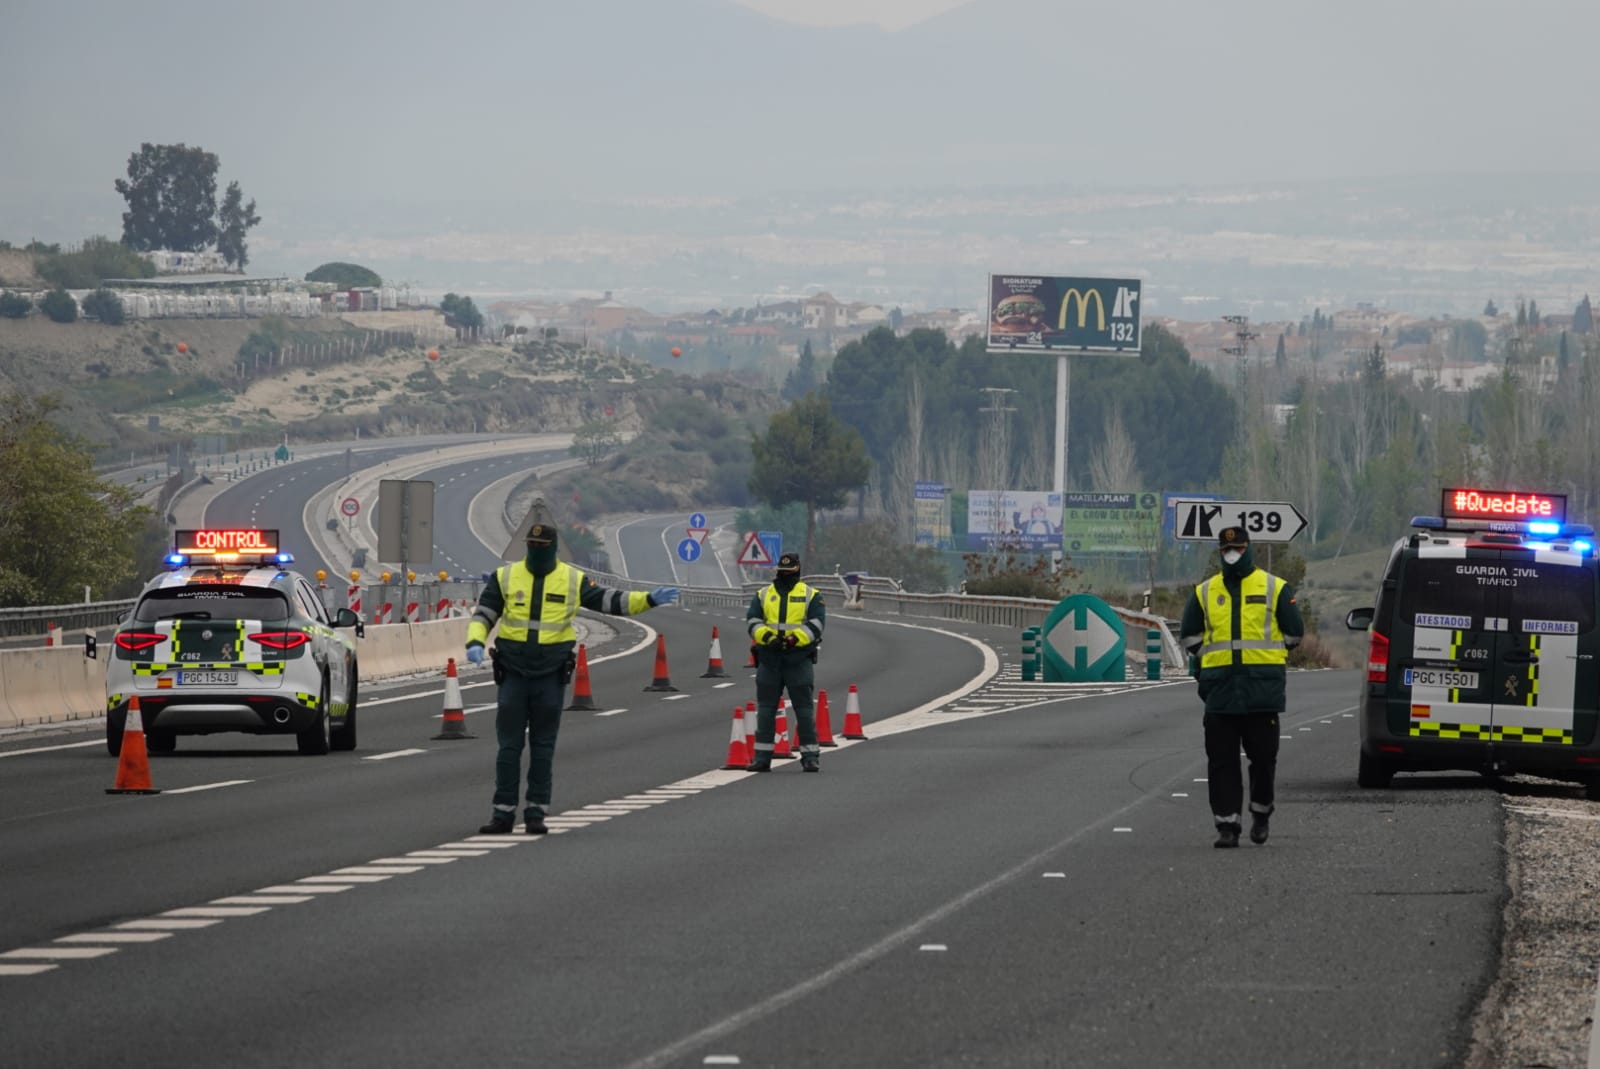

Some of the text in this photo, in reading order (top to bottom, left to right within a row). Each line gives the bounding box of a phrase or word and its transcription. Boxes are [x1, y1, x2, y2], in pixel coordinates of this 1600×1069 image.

[1110, 322, 1134, 342] 132
[1068, 494, 1130, 503] MATILLAPLANT
[1455, 491, 1552, 515] #Quedate
[1110, 510, 1120, 520] DE
[1238, 511, 1282, 533] 139
[196, 531, 267, 548] CONTROL
[1456, 565, 1539, 578] GUARDIA CIVIL
[1416, 615, 1471, 628] ATESTADOS
[1524, 621, 1576, 633] INFORMES
[186, 652, 200, 661] 062
[1471, 649, 1489, 659] 062
[183, 671, 202, 683] PGC
[1412, 671, 1436, 684] PGC
